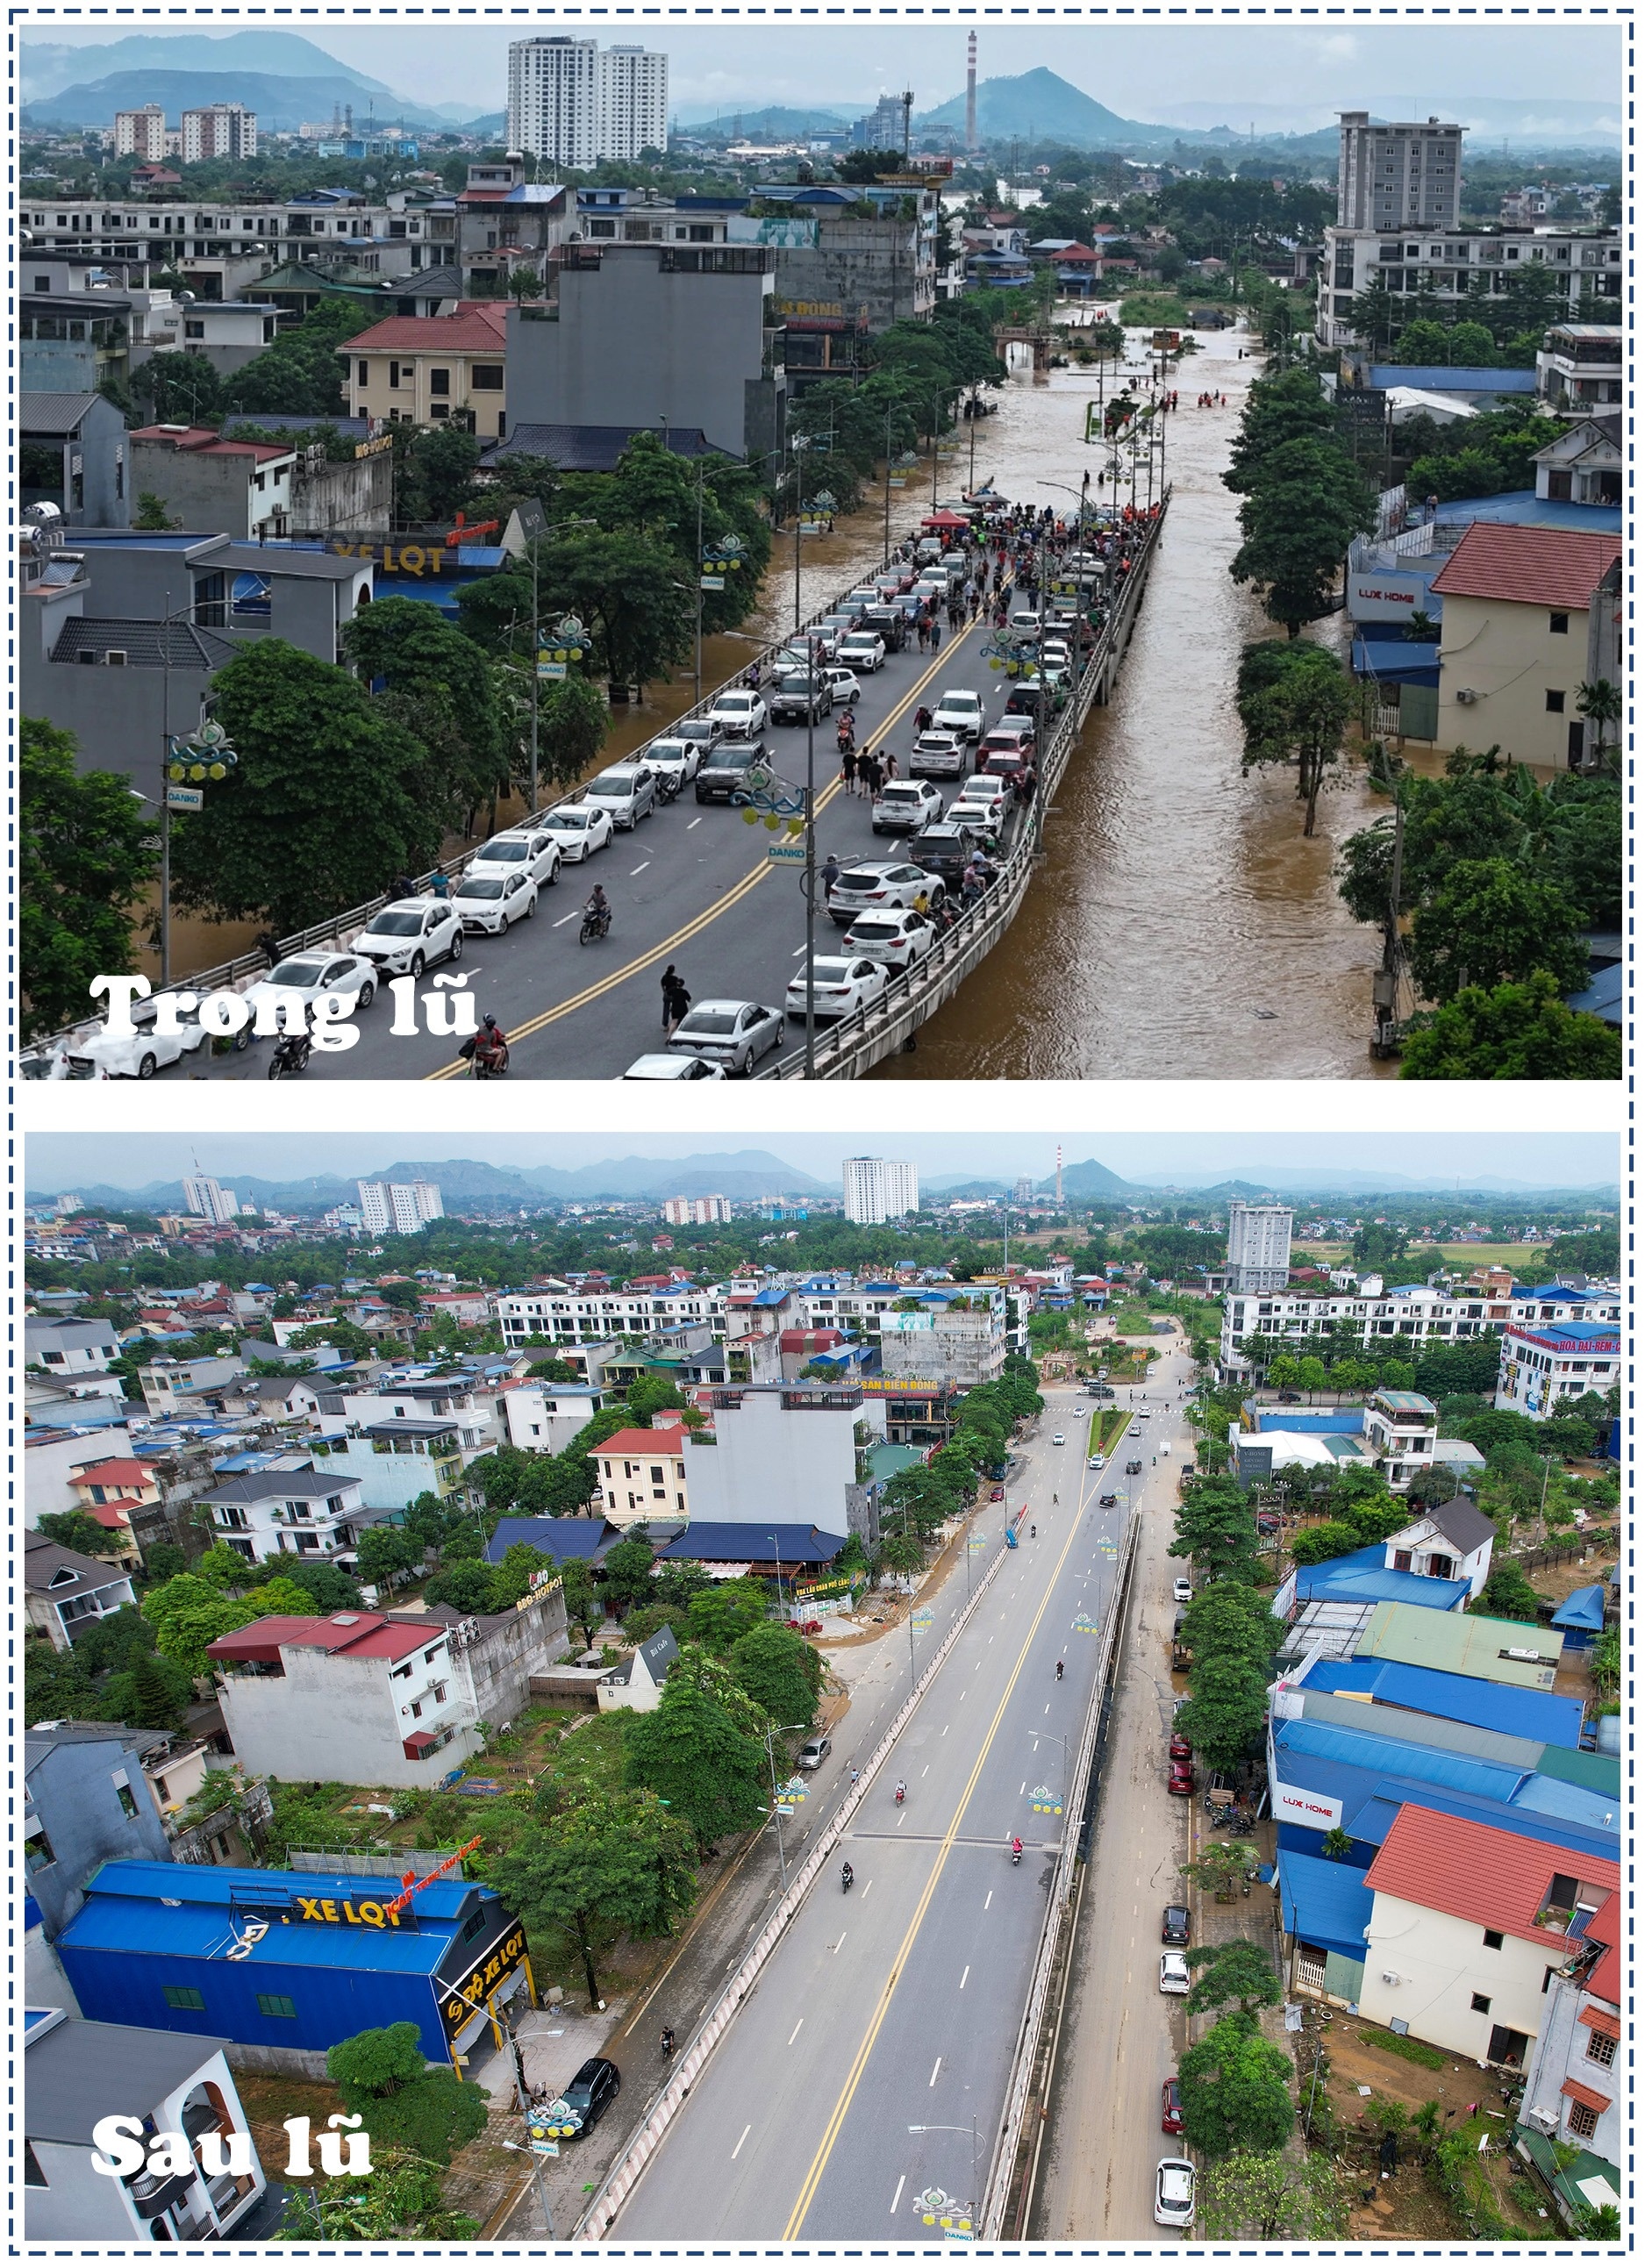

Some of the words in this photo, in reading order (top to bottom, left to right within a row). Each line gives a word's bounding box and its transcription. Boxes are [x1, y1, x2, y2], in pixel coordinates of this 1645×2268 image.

[383, 545, 446, 576] LQT
[1384, 591, 1414, 604] HOME
[168, 792, 199, 804] DANKO
[769, 848, 805, 858] DANKO
[1559, 1340, 1576, 1351] HOA
[516, 1575, 563, 1612] BBQ-HOTPOT
[1283, 1796, 1303, 1808] LUX
[1305, 1802, 1333, 1817] HOME
[386, 1888, 414, 1919] ICAR
[297, 1898, 340, 1921] XE
[343, 1900, 400, 1928] LQT
[462, 1973, 483, 2007] ĐỘ
[483, 1956, 501, 1985] XE
[499, 1929, 523, 1965] LQT
[533, 2144, 556, 2153] DANKO
[945, 2231, 972, 2241] DANKO
